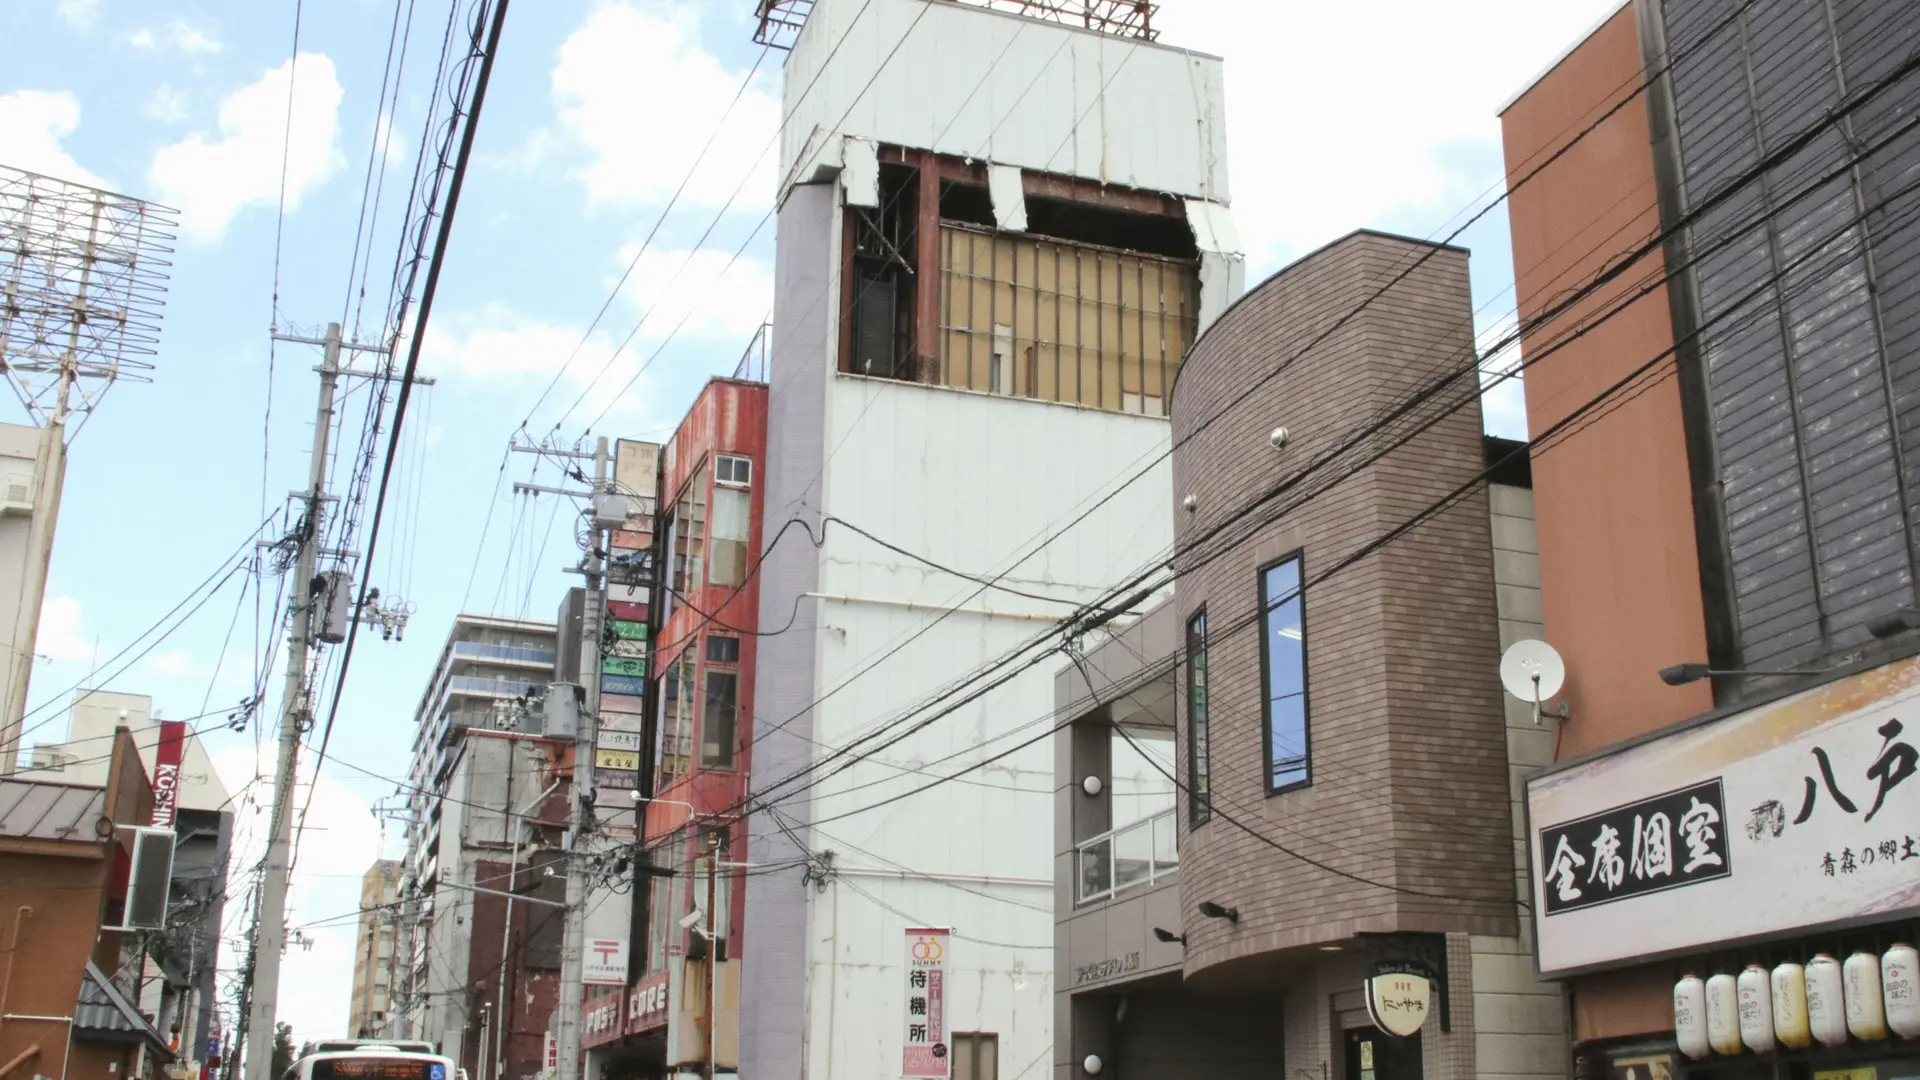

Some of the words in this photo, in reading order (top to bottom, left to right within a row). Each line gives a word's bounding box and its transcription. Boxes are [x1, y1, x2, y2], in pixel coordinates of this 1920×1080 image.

[152, 763, 178, 829] KOSHIN
[1545, 797, 1723, 902] 全席個室
[1820, 835, 1920, 877] 青森の郷土
[629, 982, 667, 1020] CORE
[909, 969, 927, 1043] 待機所
